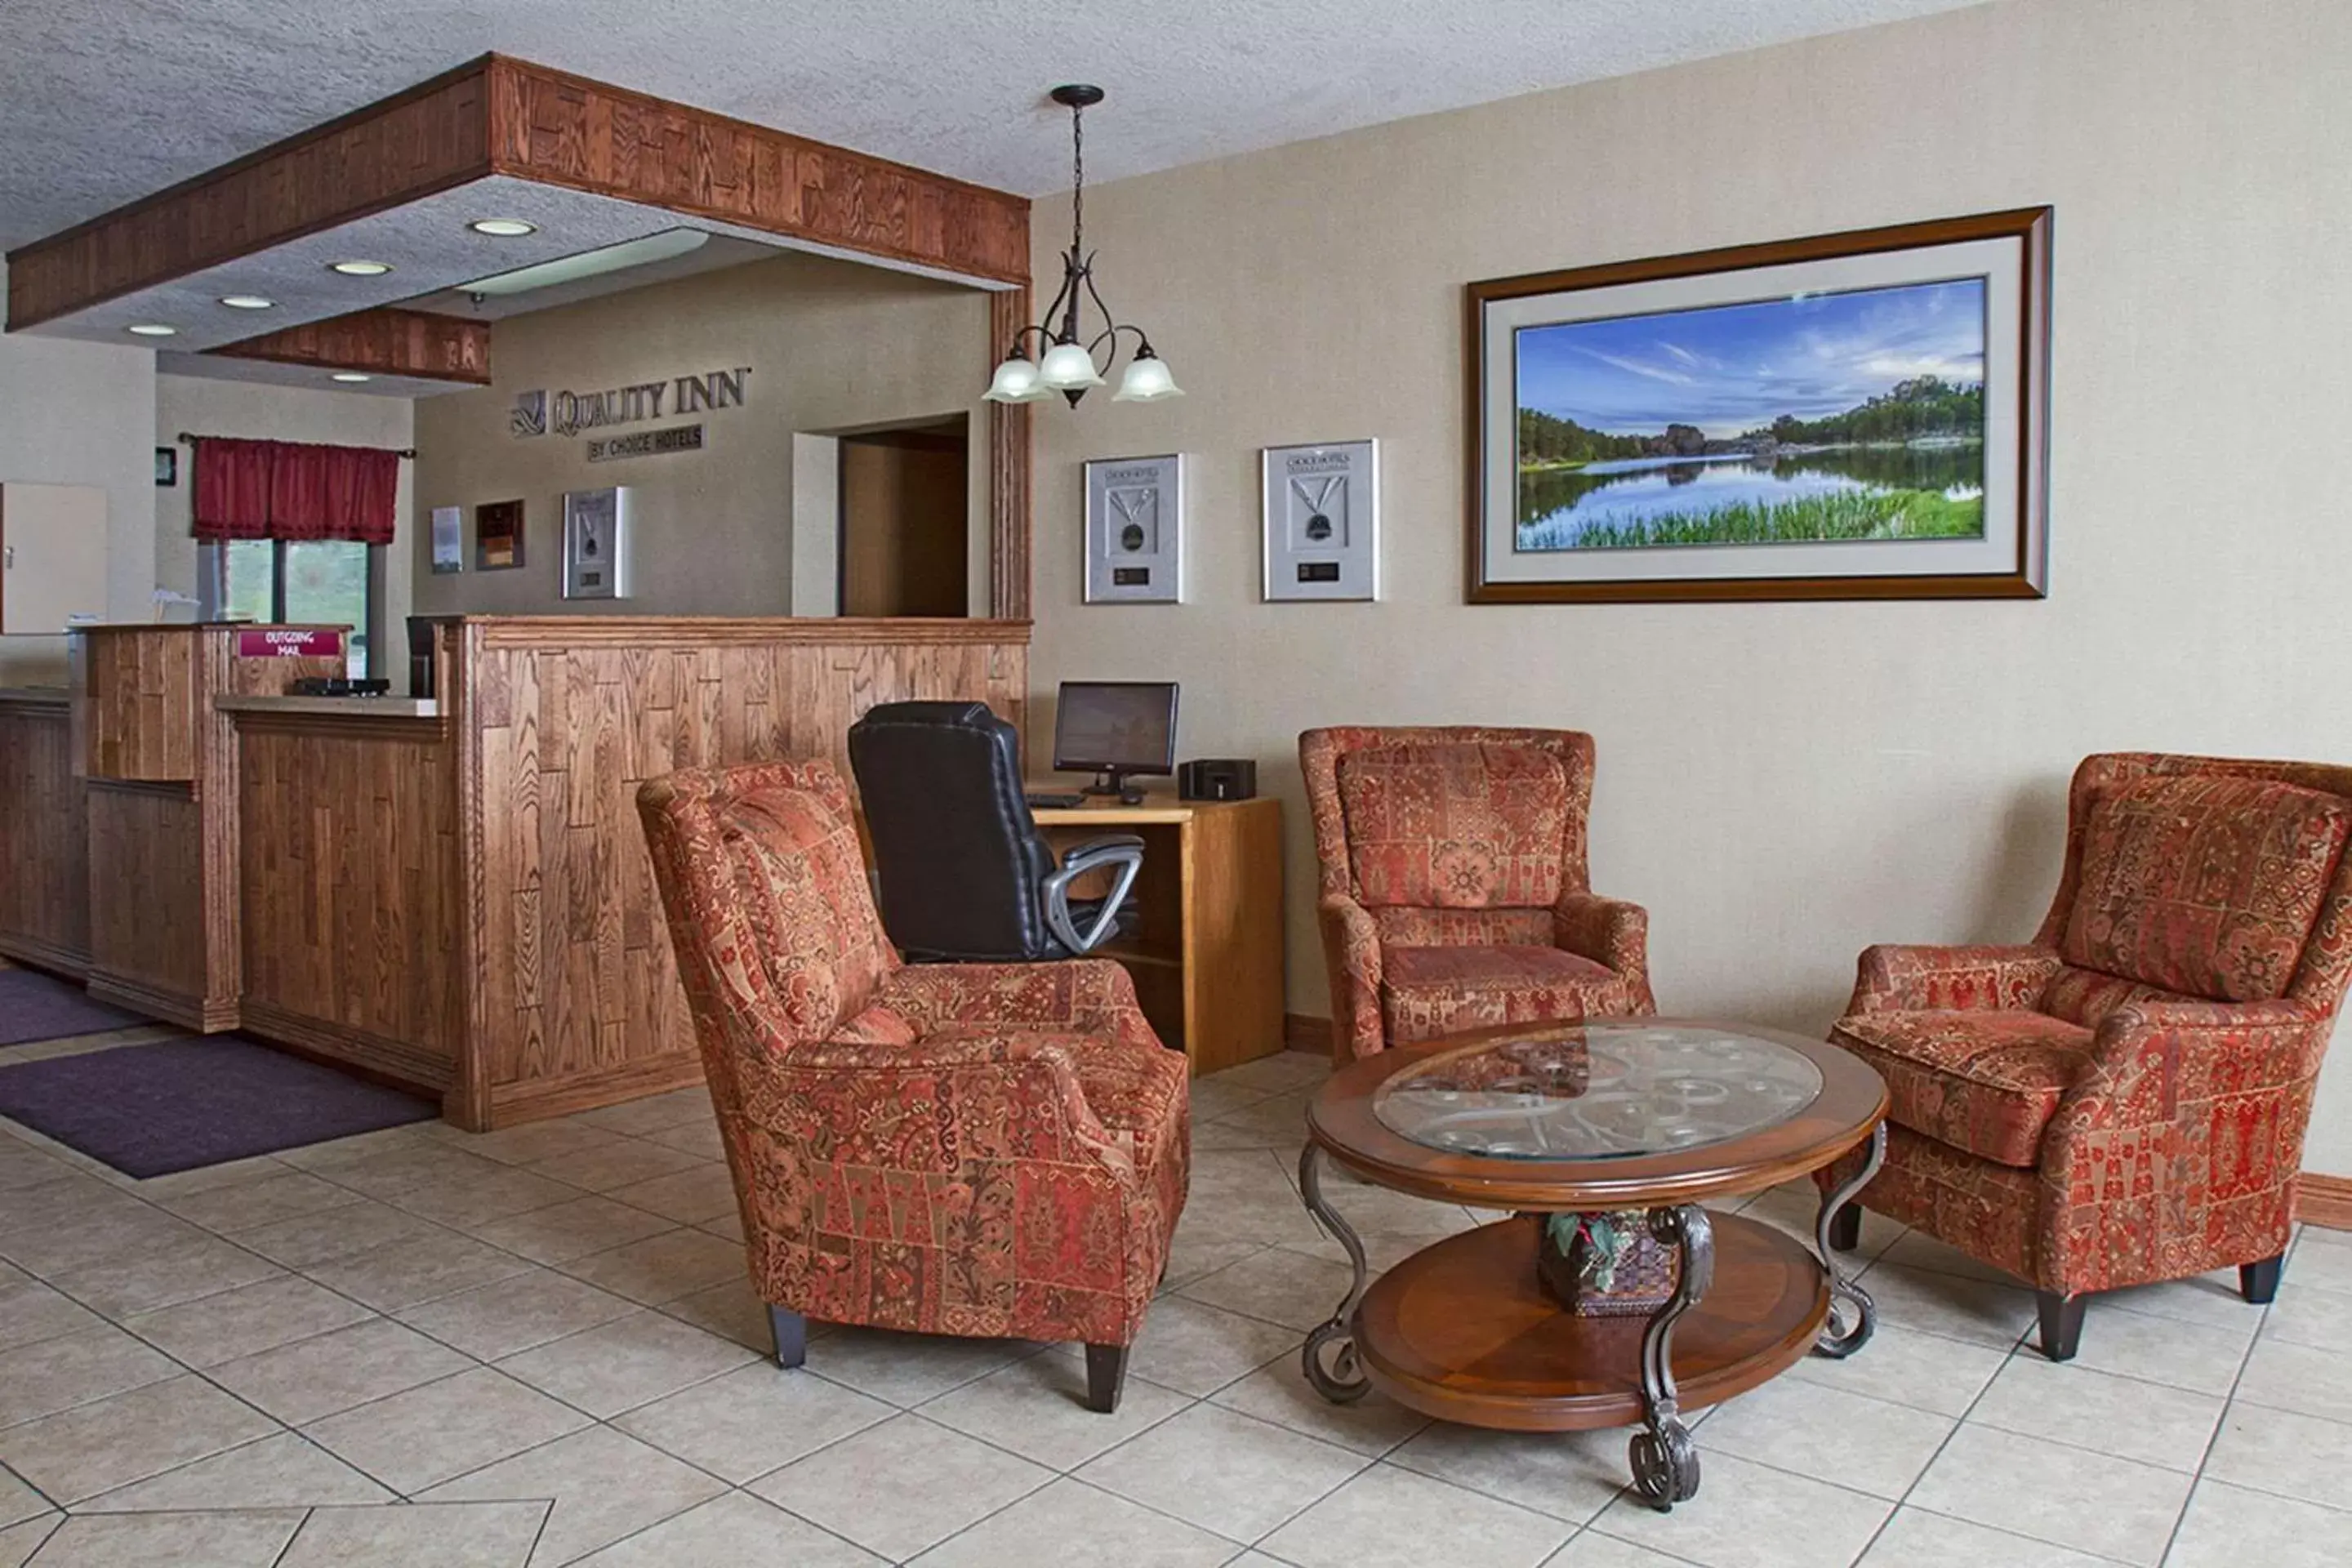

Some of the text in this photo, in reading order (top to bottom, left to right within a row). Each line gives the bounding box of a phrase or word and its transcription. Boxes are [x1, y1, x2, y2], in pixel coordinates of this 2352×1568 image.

[555, 368, 751, 437] QUALITY INN
[608, 432, 650, 456] CHOICE
[655, 425, 702, 450] HOTELS
[265, 631, 314, 644] OUTGOING
[278, 645, 301, 657] MAIL
